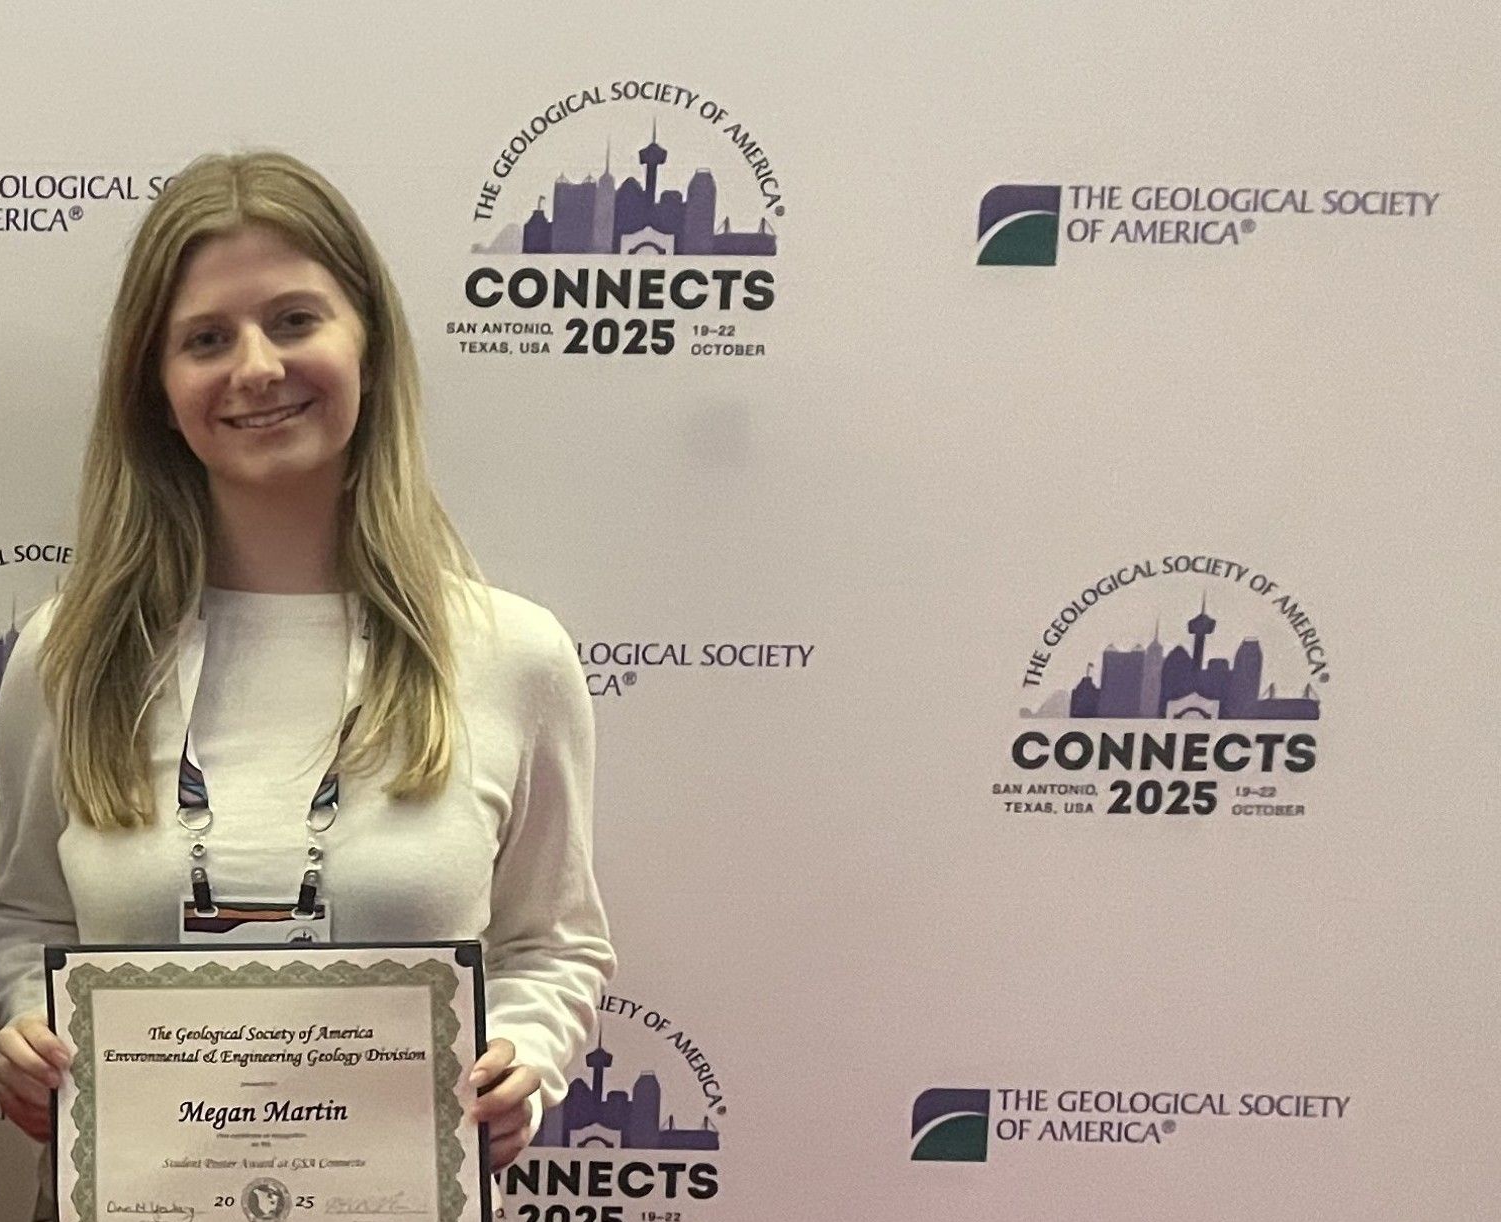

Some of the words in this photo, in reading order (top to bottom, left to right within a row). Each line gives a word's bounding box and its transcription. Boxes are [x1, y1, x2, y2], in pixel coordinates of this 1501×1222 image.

[1068, 186, 1122, 211] THE
[1130, 187, 1314, 214] GEOLOGICAL
[1322, 189, 1439, 218] SOCIETY
[1067, 218, 1105, 244] OF
[464, 268, 775, 311] CONNECTS
[564, 319, 676, 357] 2025
[1010, 731, 1317, 774] CONNECTS
[1108, 780, 1217, 817] 2025
[148, 1027, 171, 1041] The
[176, 1025, 244, 1044] Geological
[246, 1027, 296, 1044] Society
[298, 1026, 316, 1044] of
[315, 1027, 373, 1040] America
[104, 1050, 199, 1063] Environmental
[203, 1050, 217, 1063] &
[221, 1050, 302, 1066] Engineering
[306, 1050, 362, 1065] Geology
[365, 1049, 425, 1062] Division
[179, 1101, 256, 1129] Megan
[264, 1100, 348, 1122] Martin
[214, 1196, 234, 1208] 20
[296, 1196, 314, 1208] 25
